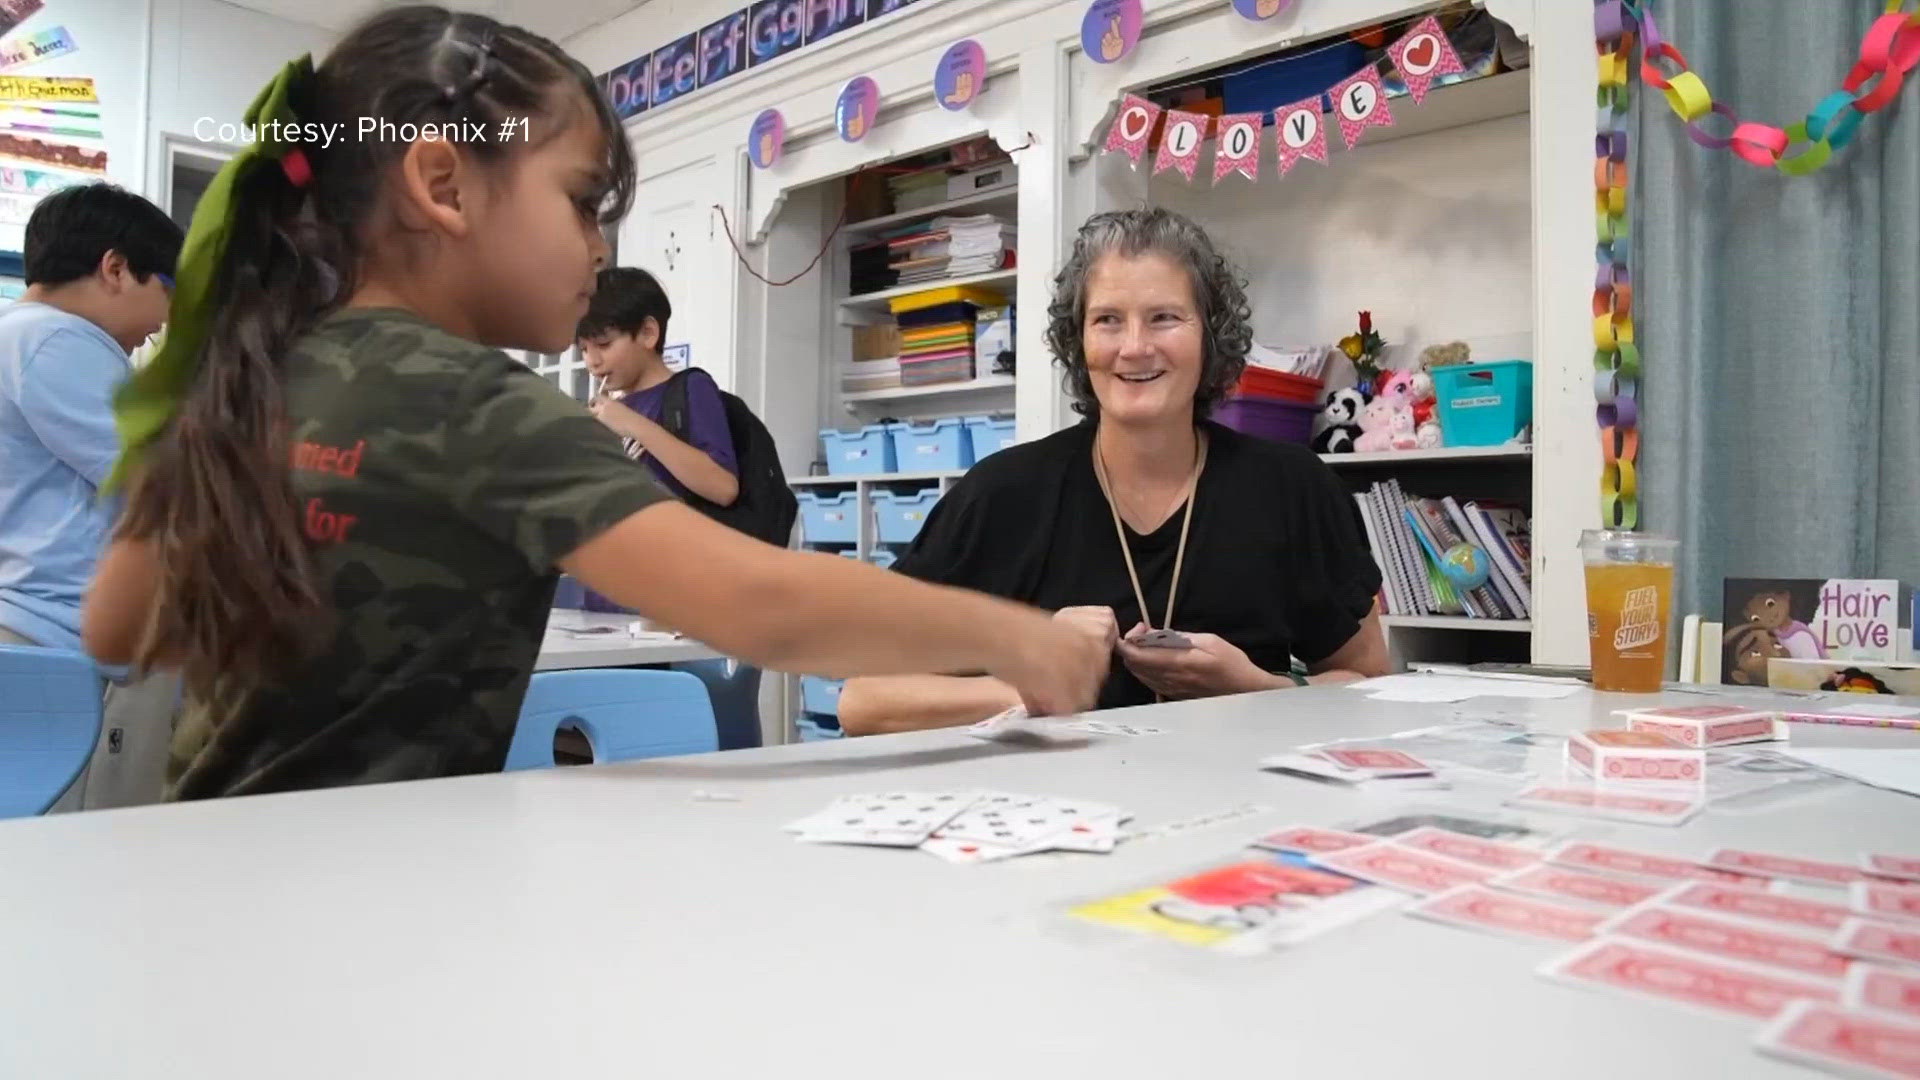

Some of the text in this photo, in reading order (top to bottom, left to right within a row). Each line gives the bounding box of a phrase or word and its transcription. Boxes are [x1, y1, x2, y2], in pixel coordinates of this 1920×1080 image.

[1626, 588, 1655, 608] FUEL
[1822, 583, 1891, 618] Hair
[1621, 606, 1655, 627] YOUR
[1822, 619, 1889, 649] Love
